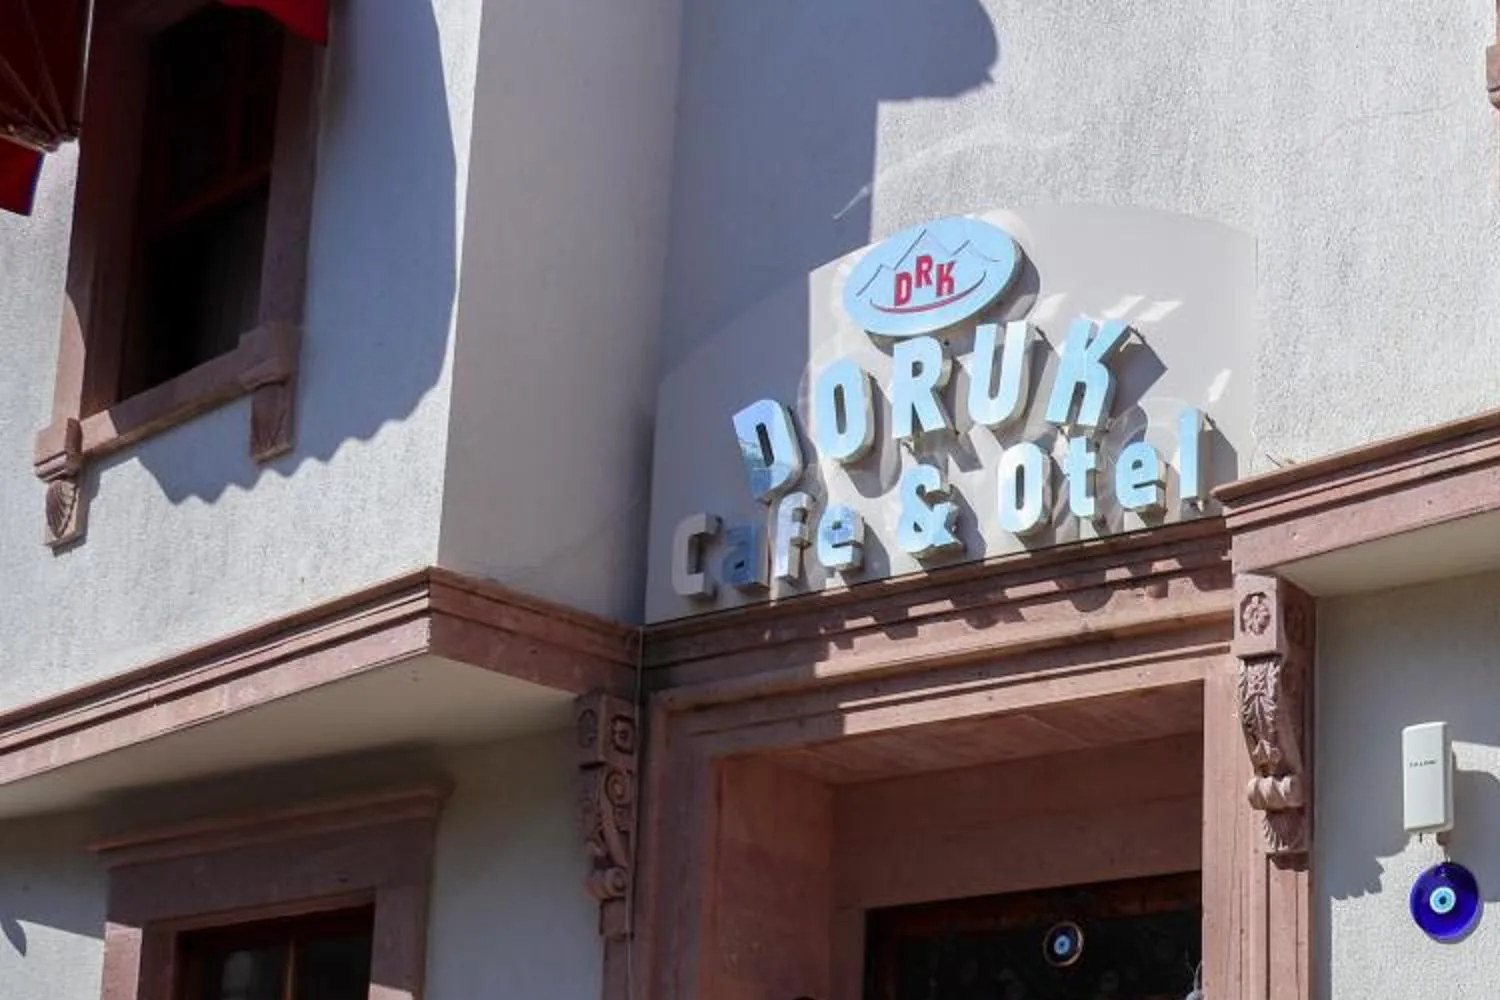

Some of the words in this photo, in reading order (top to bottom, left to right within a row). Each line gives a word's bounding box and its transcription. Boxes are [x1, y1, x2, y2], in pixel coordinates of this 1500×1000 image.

[894, 254, 955, 306] DRK
[731, 319, 1134, 501] DORUK
[671, 491, 862, 598] Cafe
[897, 463, 962, 554] &
[997, 408, 1201, 533] Otel
